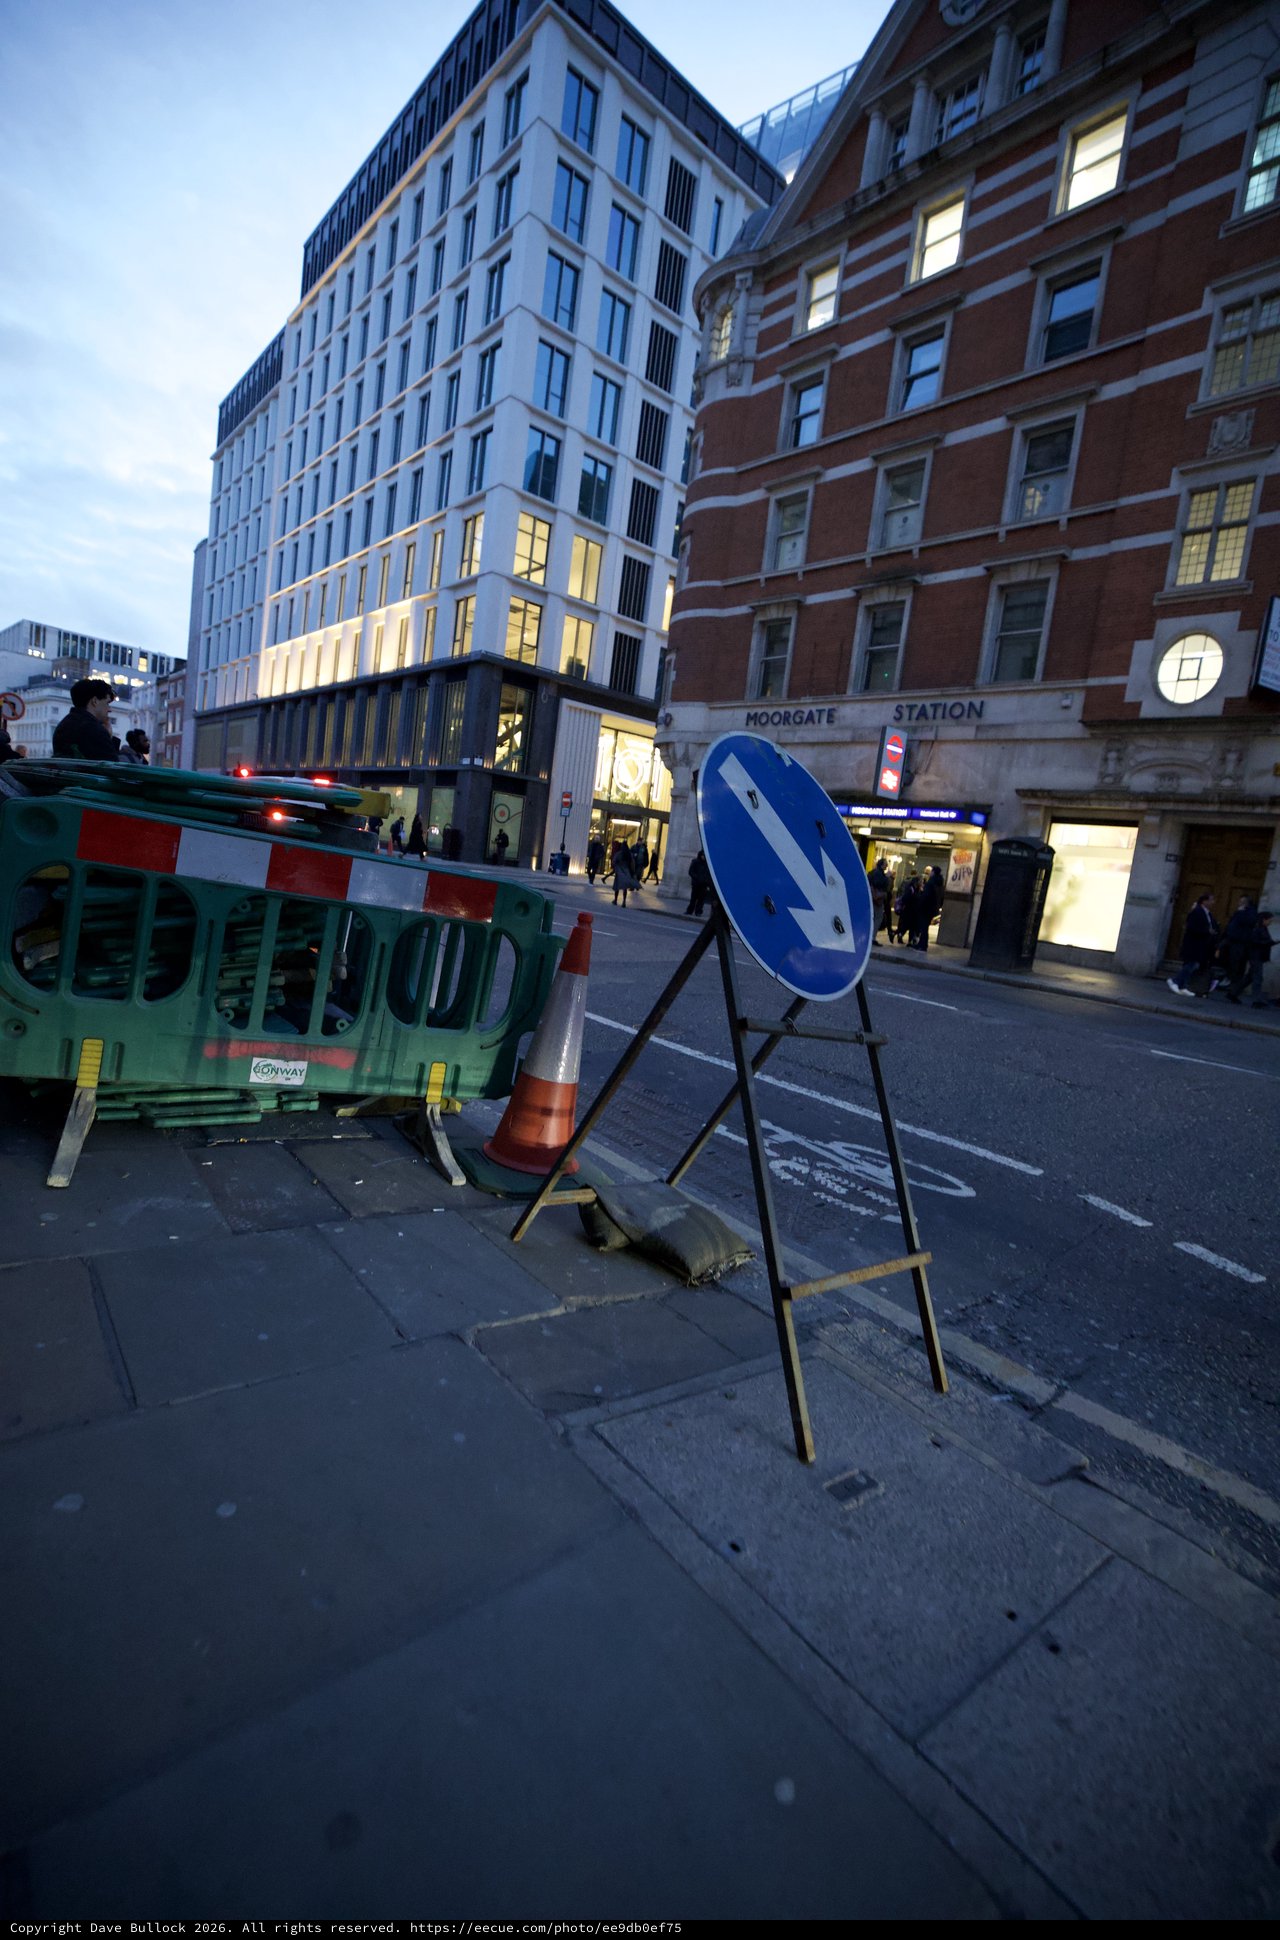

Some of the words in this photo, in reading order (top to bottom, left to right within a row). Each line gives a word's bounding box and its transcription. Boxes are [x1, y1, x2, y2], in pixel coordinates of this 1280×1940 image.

[745, 707, 837, 727] MOORGATE
[893, 700, 984, 722] STATION
[851, 806, 883, 816] MOORGATE
[883, 807, 908, 817] STATION
[253, 1062, 305, 1078] CONWAY
